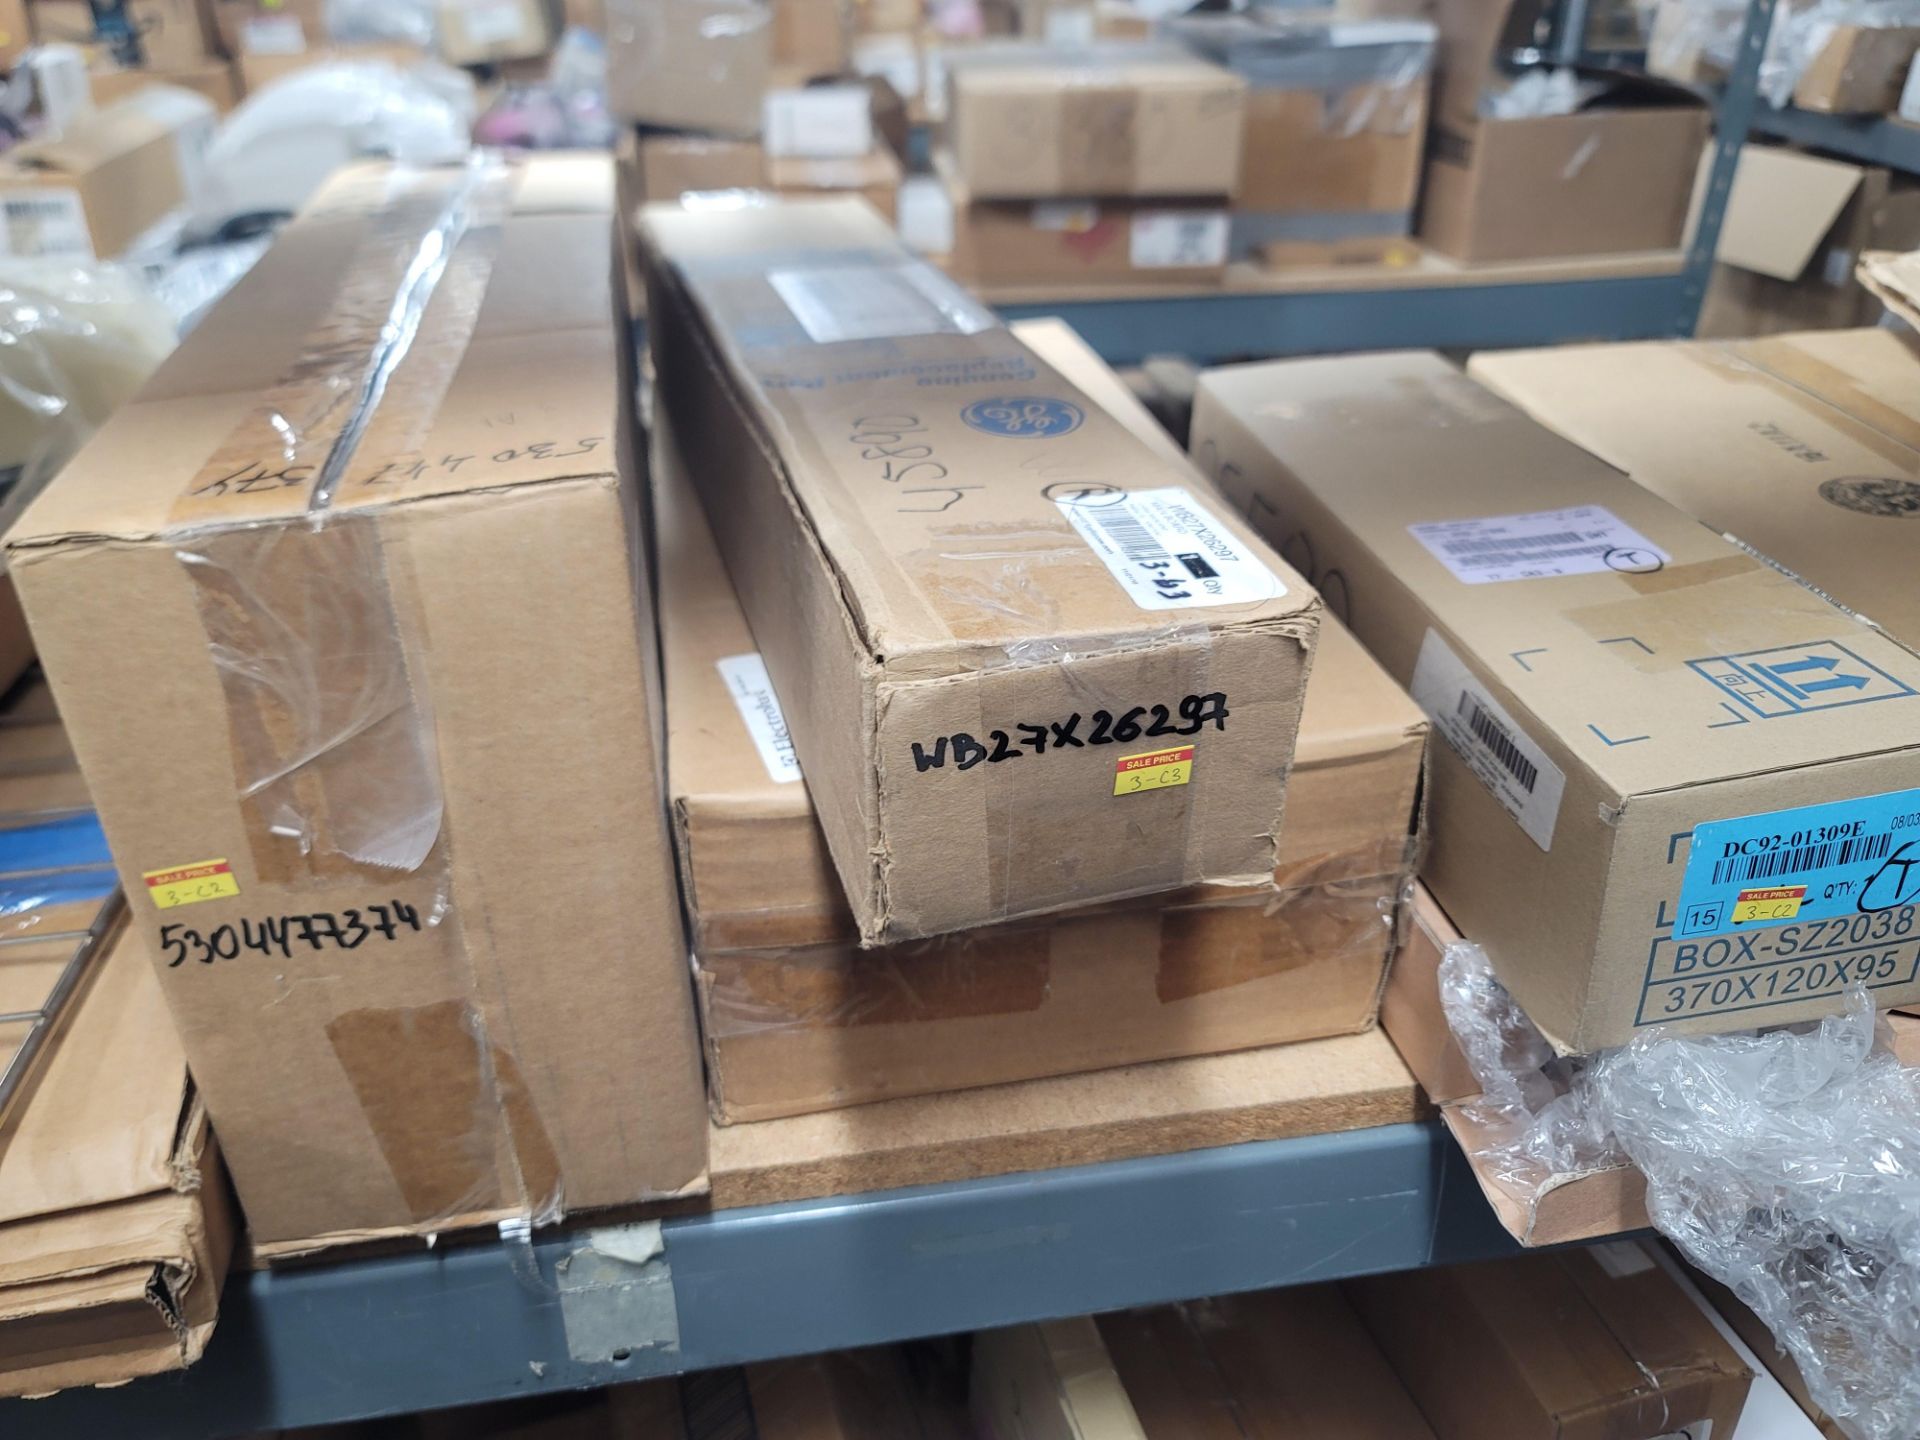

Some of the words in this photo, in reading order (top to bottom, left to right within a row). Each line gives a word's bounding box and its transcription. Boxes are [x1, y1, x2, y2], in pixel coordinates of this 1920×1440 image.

[1167, 504, 1240, 562] WB27X26297
[910, 691, 1230, 773] WB27X26297
[1125, 757, 1152, 770] SALE
[1153, 752, 1182, 765] PRICE
[1130, 767, 1182, 791] 3-C3
[1722, 820, 1867, 858] DC92-01309E
[155, 872, 185, 885] SALE
[185, 865, 216, 879] PRICE
[1823, 881, 1858, 899] Q'TY:
[1769, 890, 1795, 898] PRICE
[160, 899, 421, 968] 5304477374
[1690, 909, 1716, 927] 15
[1672, 905, 1916, 974] BOX-SZ2038
[1664, 949, 1899, 1014] 370X120X95
